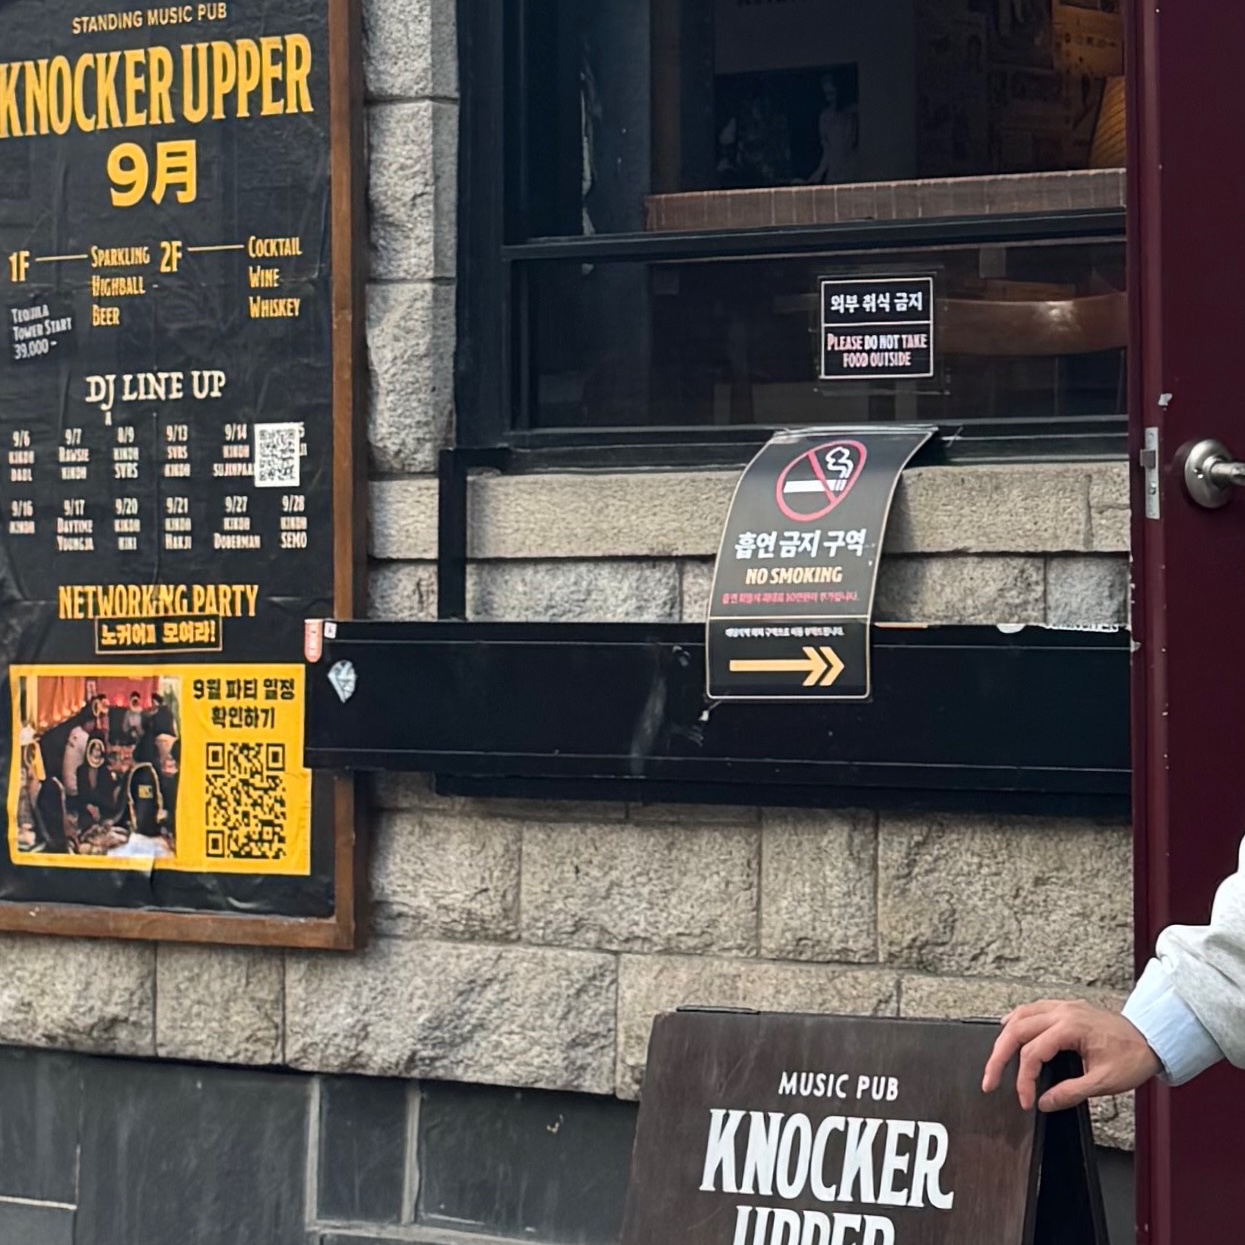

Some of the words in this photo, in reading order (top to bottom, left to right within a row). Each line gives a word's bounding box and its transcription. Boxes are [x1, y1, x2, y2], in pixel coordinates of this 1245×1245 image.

[72, 12, 143, 34] STANDING
[147, 6, 193, 26] MUSIC
[197, 2, 228, 21] PUB
[0, 46, 175, 138] KNOCKER
[181, 33, 314, 123] UPPER
[106, 139, 198, 207] 9月
[90, 245, 150, 267] SPARKLING
[159, 241, 183, 273] 2F
[248, 236, 303, 258] COCKTAIL
[8, 250, 30, 282] 1F
[248, 266, 280, 288] WINE
[91, 275, 146, 297] HIGHBALL
[248, 296, 301, 318] WHISKEY
[830, 294, 860, 313] 외부
[862, 293, 890, 312] 취식
[894, 291, 922, 311] 금지
[91, 305, 120, 327] BEER
[12, 322, 44, 342] TOWER
[44, 317, 73, 335] START
[827, 333, 863, 350] PLEASE
[864, 335, 878, 350] DO
[879, 335, 900, 349] NOT
[901, 334, 928, 348] TAKE
[843, 353, 869, 368] FOOD
[870, 352, 911, 367] OUTSIDE
[84, 374, 117, 411] DJ
[122, 371, 184, 401] LINE
[191, 370, 226, 399] UP
[65, 428, 82, 445] 9/7
[166, 424, 189, 442] 9/13
[225, 423, 247, 441] 9/14
[64, 499, 85, 516] 9/17
[115, 498, 138, 515] 9/20
[166, 496, 189, 513] 9/21
[225, 496, 248, 513] 9/27
[282, 495, 305, 513] 9/28
[734, 531, 777, 559] 흡연
[779, 529, 821, 558] 금지
[823, 528, 867, 557] 구역
[745, 567, 769, 584] NO
[769, 566, 843, 584] SMOKING
[192, 584, 259, 618] PARTY
[193, 678, 221, 700] 9월
[226, 678, 258, 700] 파티
[263, 678, 295, 700] 일정
[211, 705, 275, 729] 확인하기
[778, 1071, 849, 1099] MUSIC
[856, 1074, 899, 1101] PUB
[699, 1108, 954, 1209] KNOCKER
